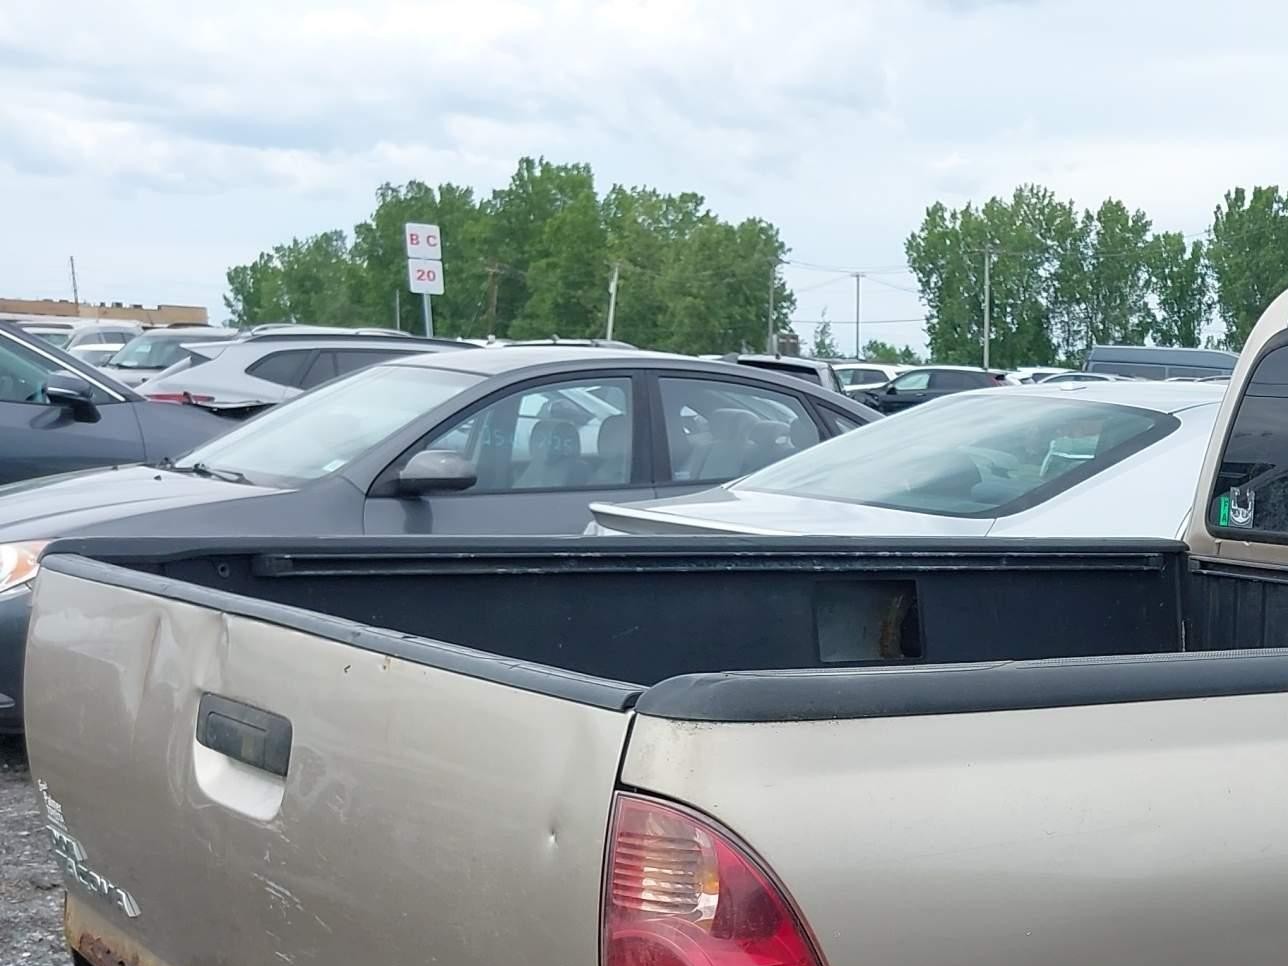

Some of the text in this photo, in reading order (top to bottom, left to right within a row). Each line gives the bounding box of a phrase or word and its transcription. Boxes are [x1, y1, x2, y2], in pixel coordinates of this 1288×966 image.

[410, 233, 438, 247] B C
[416, 269, 436, 282] 20
